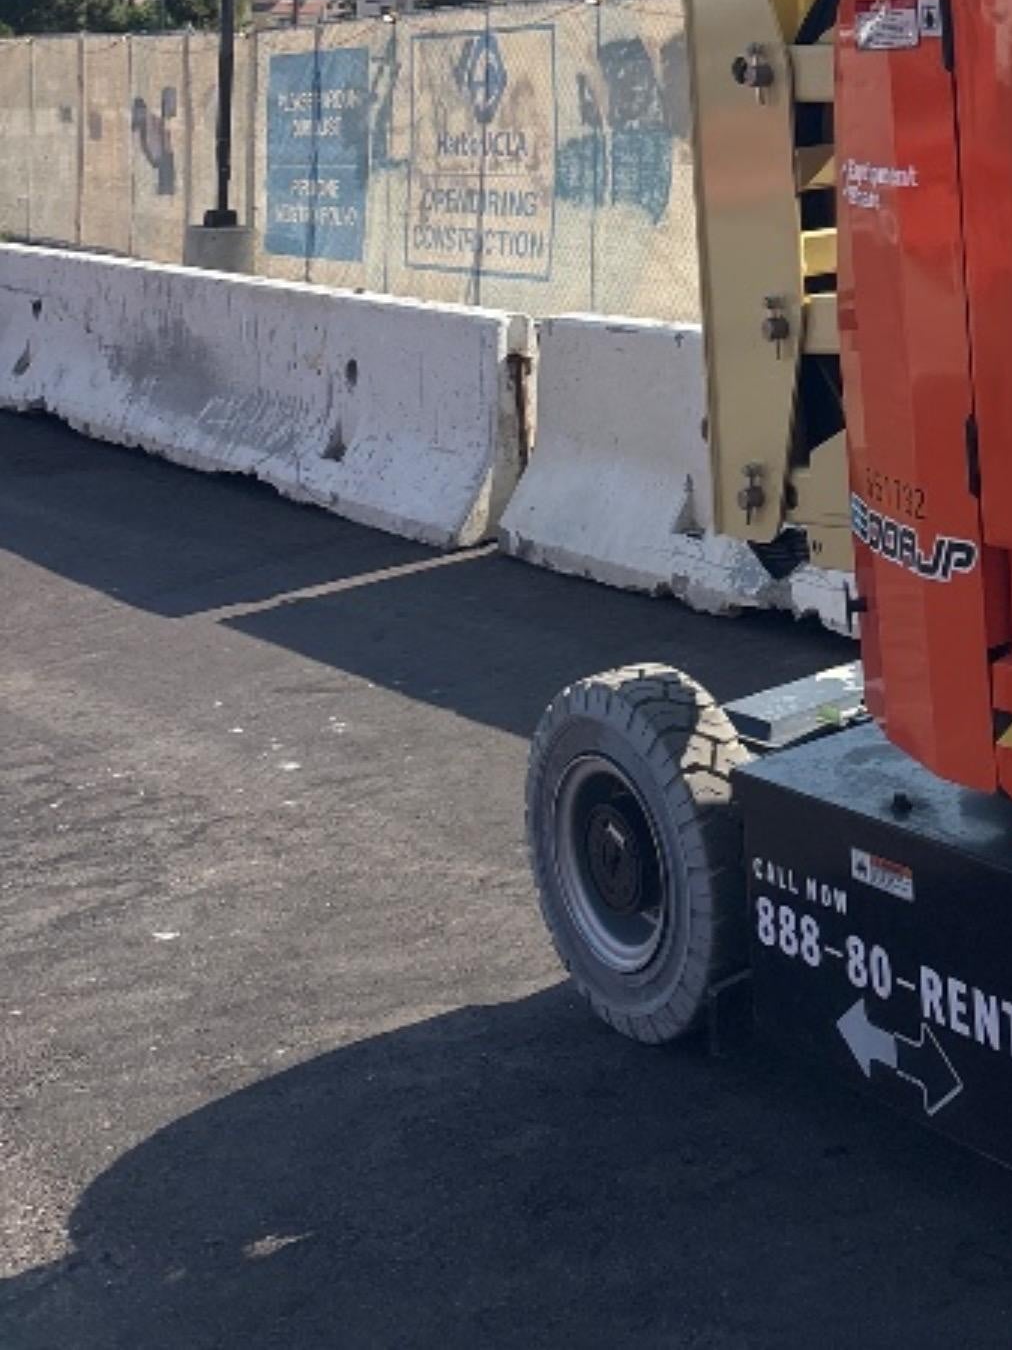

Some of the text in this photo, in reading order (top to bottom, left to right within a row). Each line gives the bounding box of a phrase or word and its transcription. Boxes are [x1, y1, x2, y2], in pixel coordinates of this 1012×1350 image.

[466, 188, 538, 220] DRING
[412, 223, 544, 260] CONSTRCTION
[752, 856, 849, 916] CALL NOW
